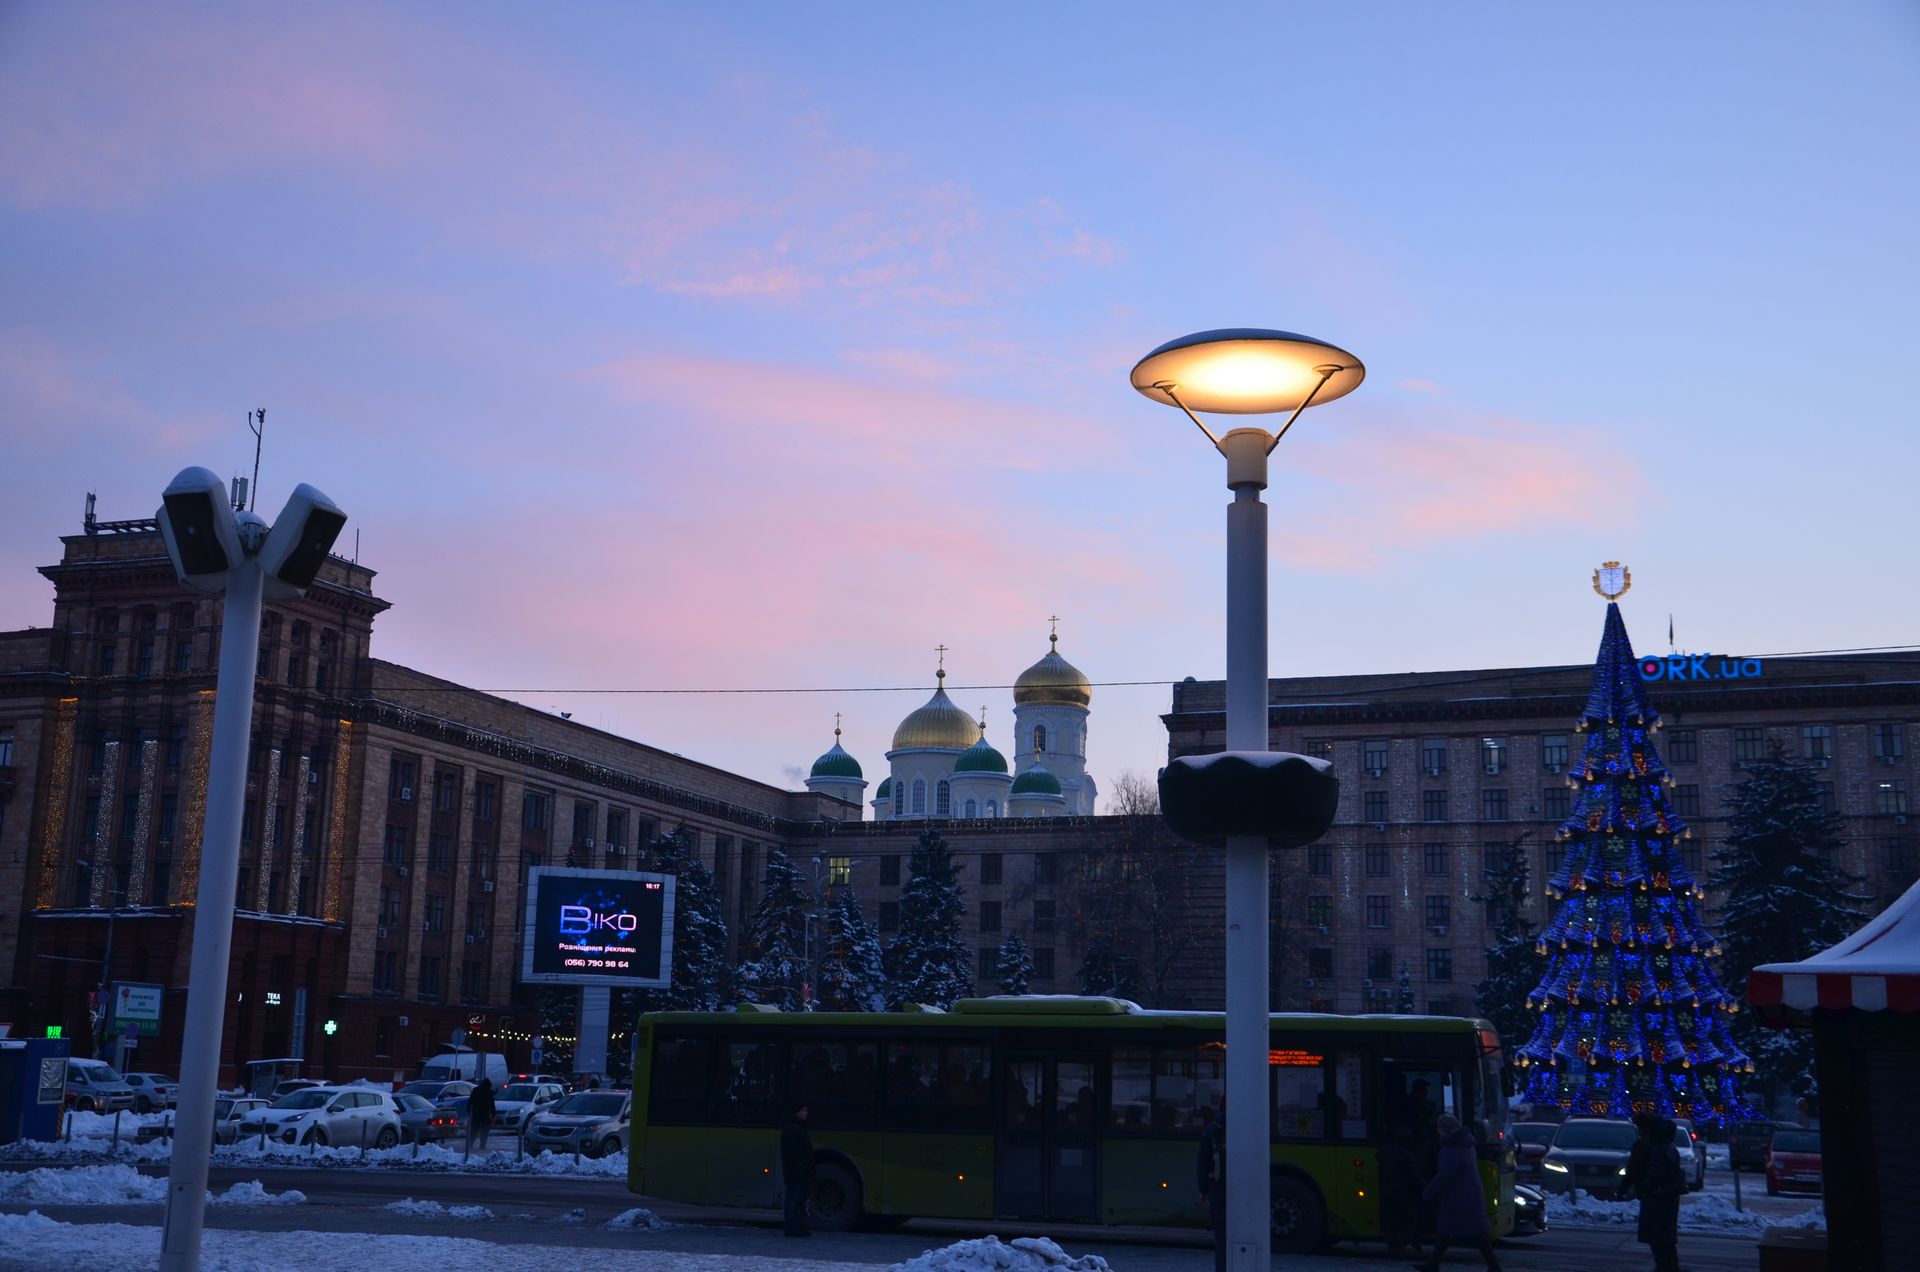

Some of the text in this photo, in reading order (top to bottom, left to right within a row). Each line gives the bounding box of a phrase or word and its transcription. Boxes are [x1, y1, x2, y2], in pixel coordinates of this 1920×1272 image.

[1638, 652, 1762, 681] ORK.ua
[564, 959, 586, 967] (056)
[605, 960, 616, 968] 98
[618, 960, 629, 968] 64
